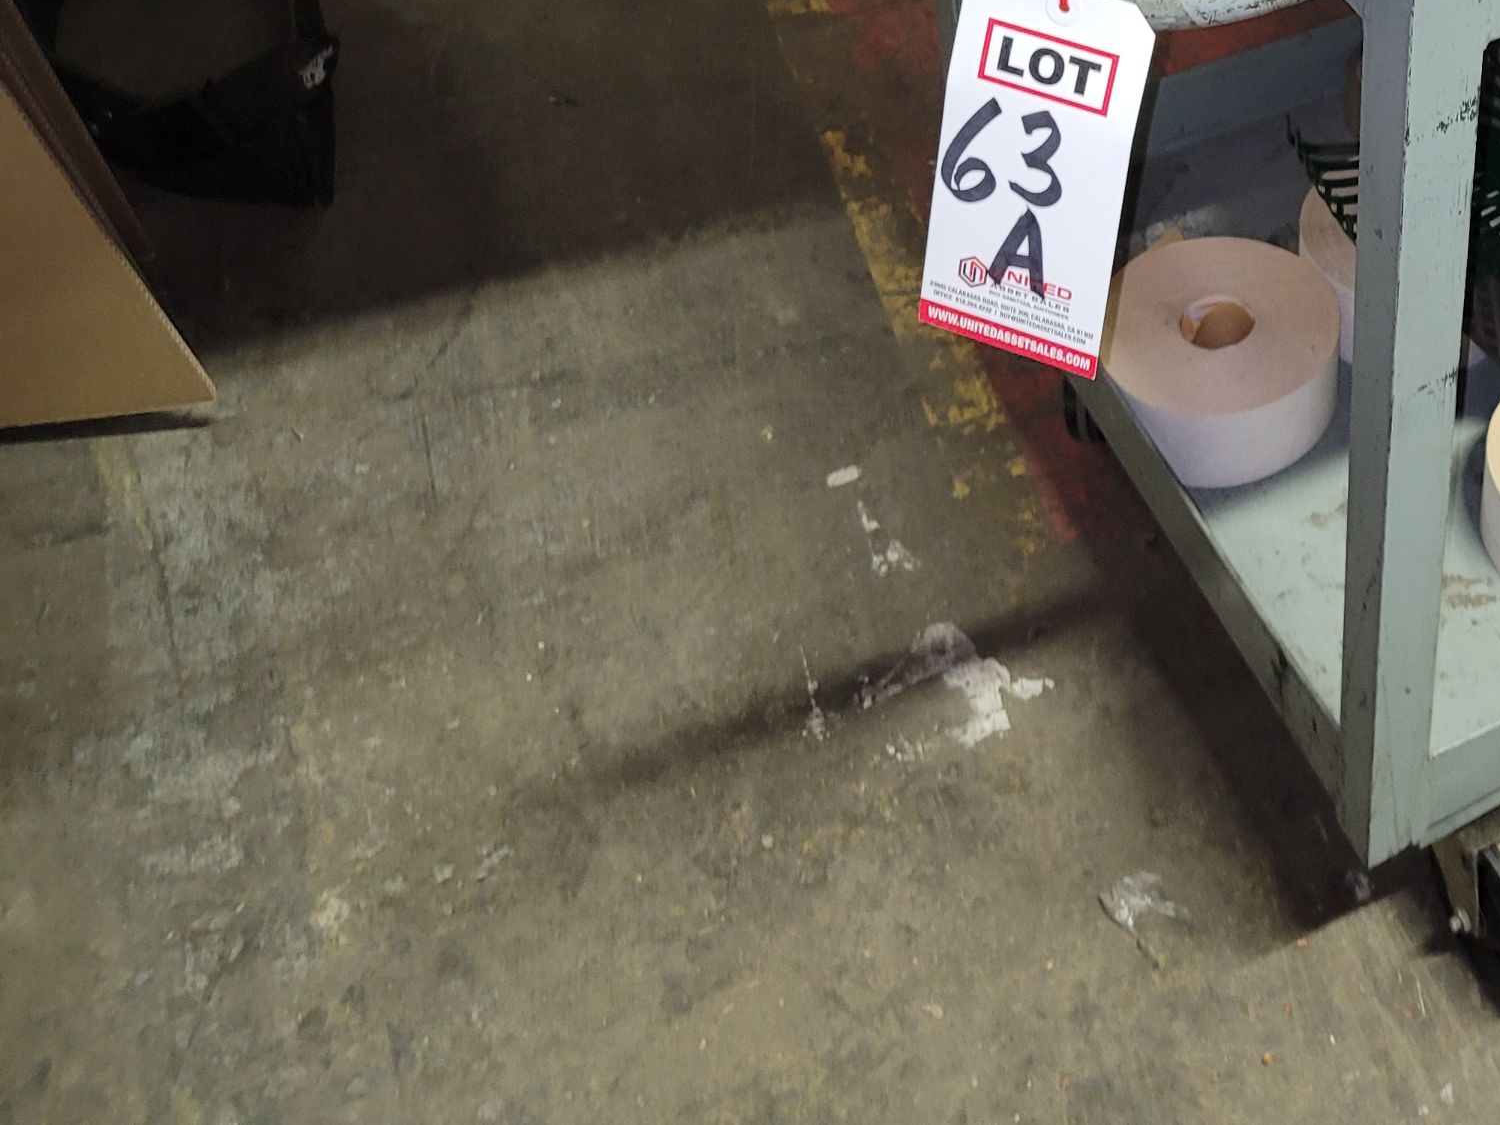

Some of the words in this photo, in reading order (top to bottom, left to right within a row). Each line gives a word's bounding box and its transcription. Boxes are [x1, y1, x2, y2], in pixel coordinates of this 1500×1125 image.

[997, 35, 1102, 97] LOT
[940, 97, 1062, 208] 63
[987, 206, 1045, 300] A
[990, 266, 1072, 301] NIED
[927, 305, 1091, 372] WWW.UNITEDASSETSALES.COM
